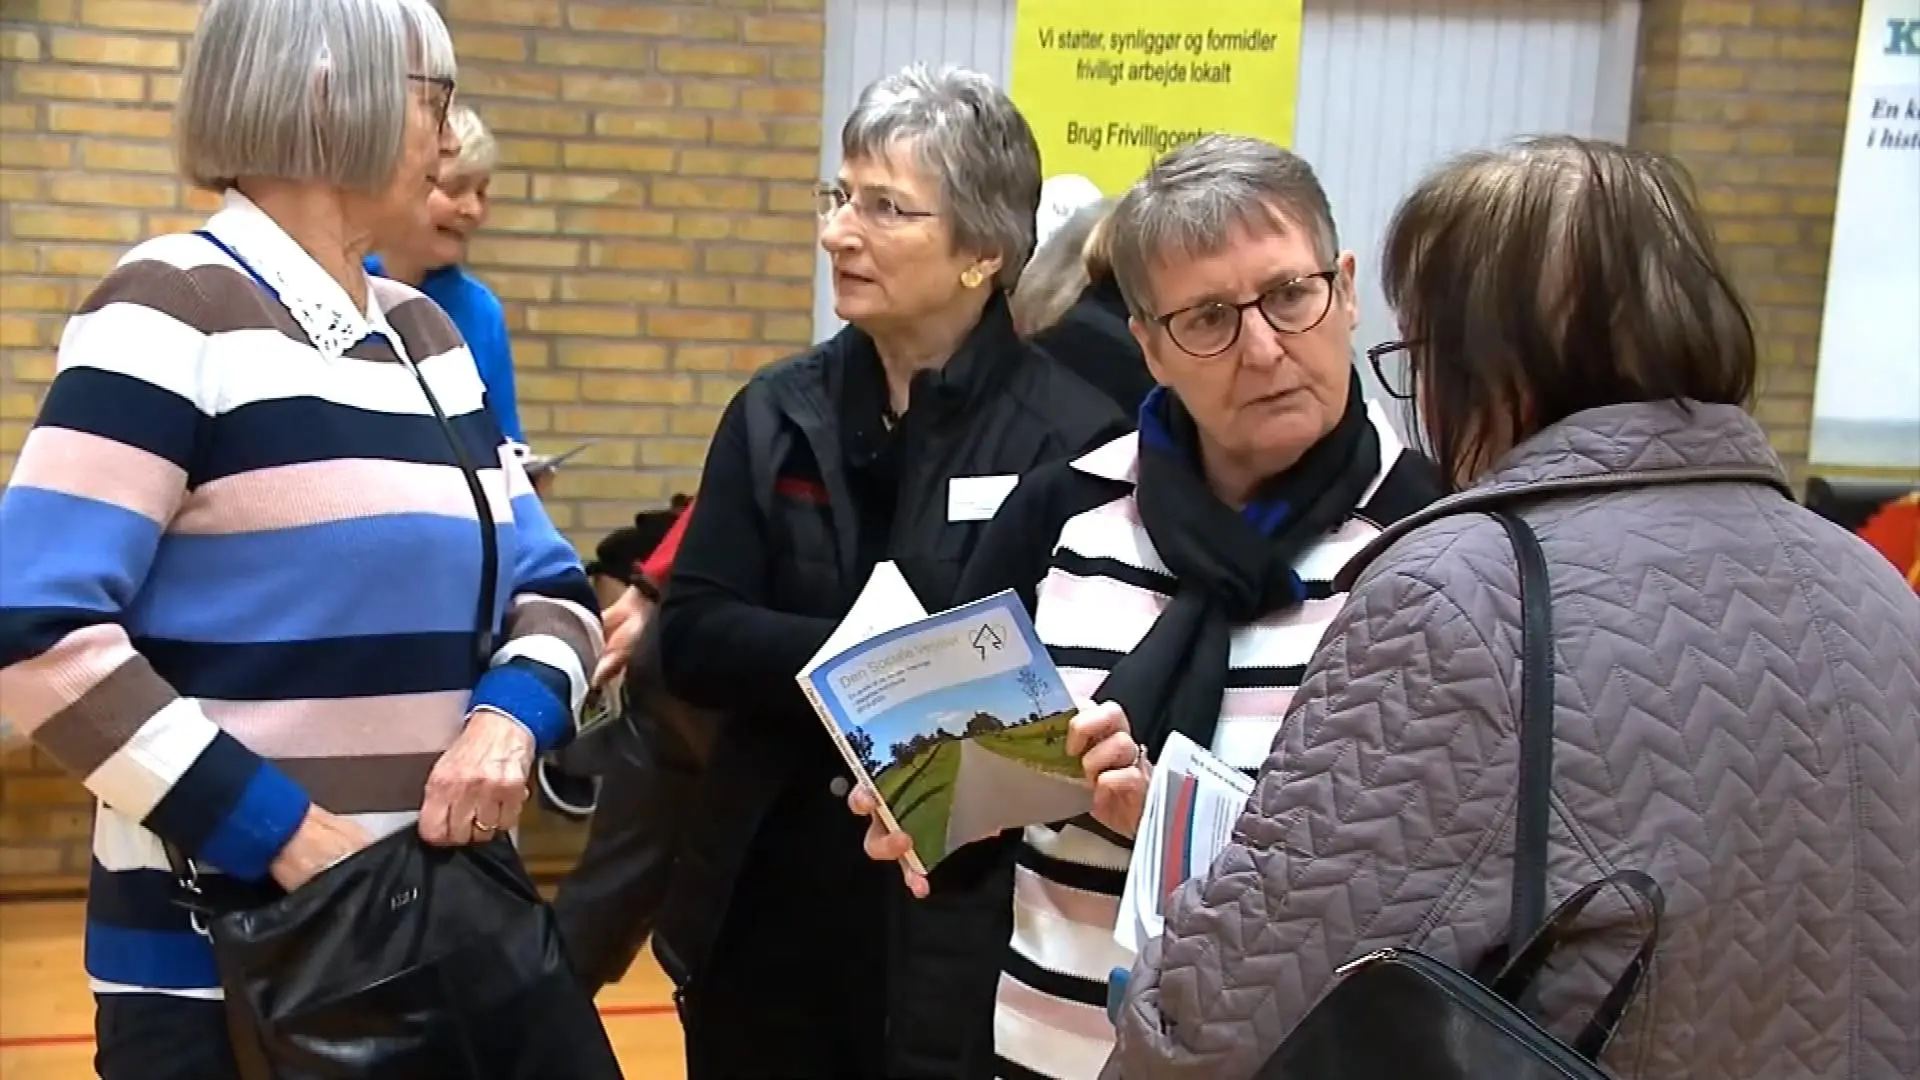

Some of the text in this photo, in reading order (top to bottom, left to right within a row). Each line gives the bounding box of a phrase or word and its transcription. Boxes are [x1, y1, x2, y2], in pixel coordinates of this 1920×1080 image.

[1039, 28, 1277, 55] Vi støtter, synliggør og formidler
[1076, 61, 1231, 86] frivilligt arbejde lokalt
[1871, 98, 1920, 119] En k
[1067, 121, 1102, 150] Brug
